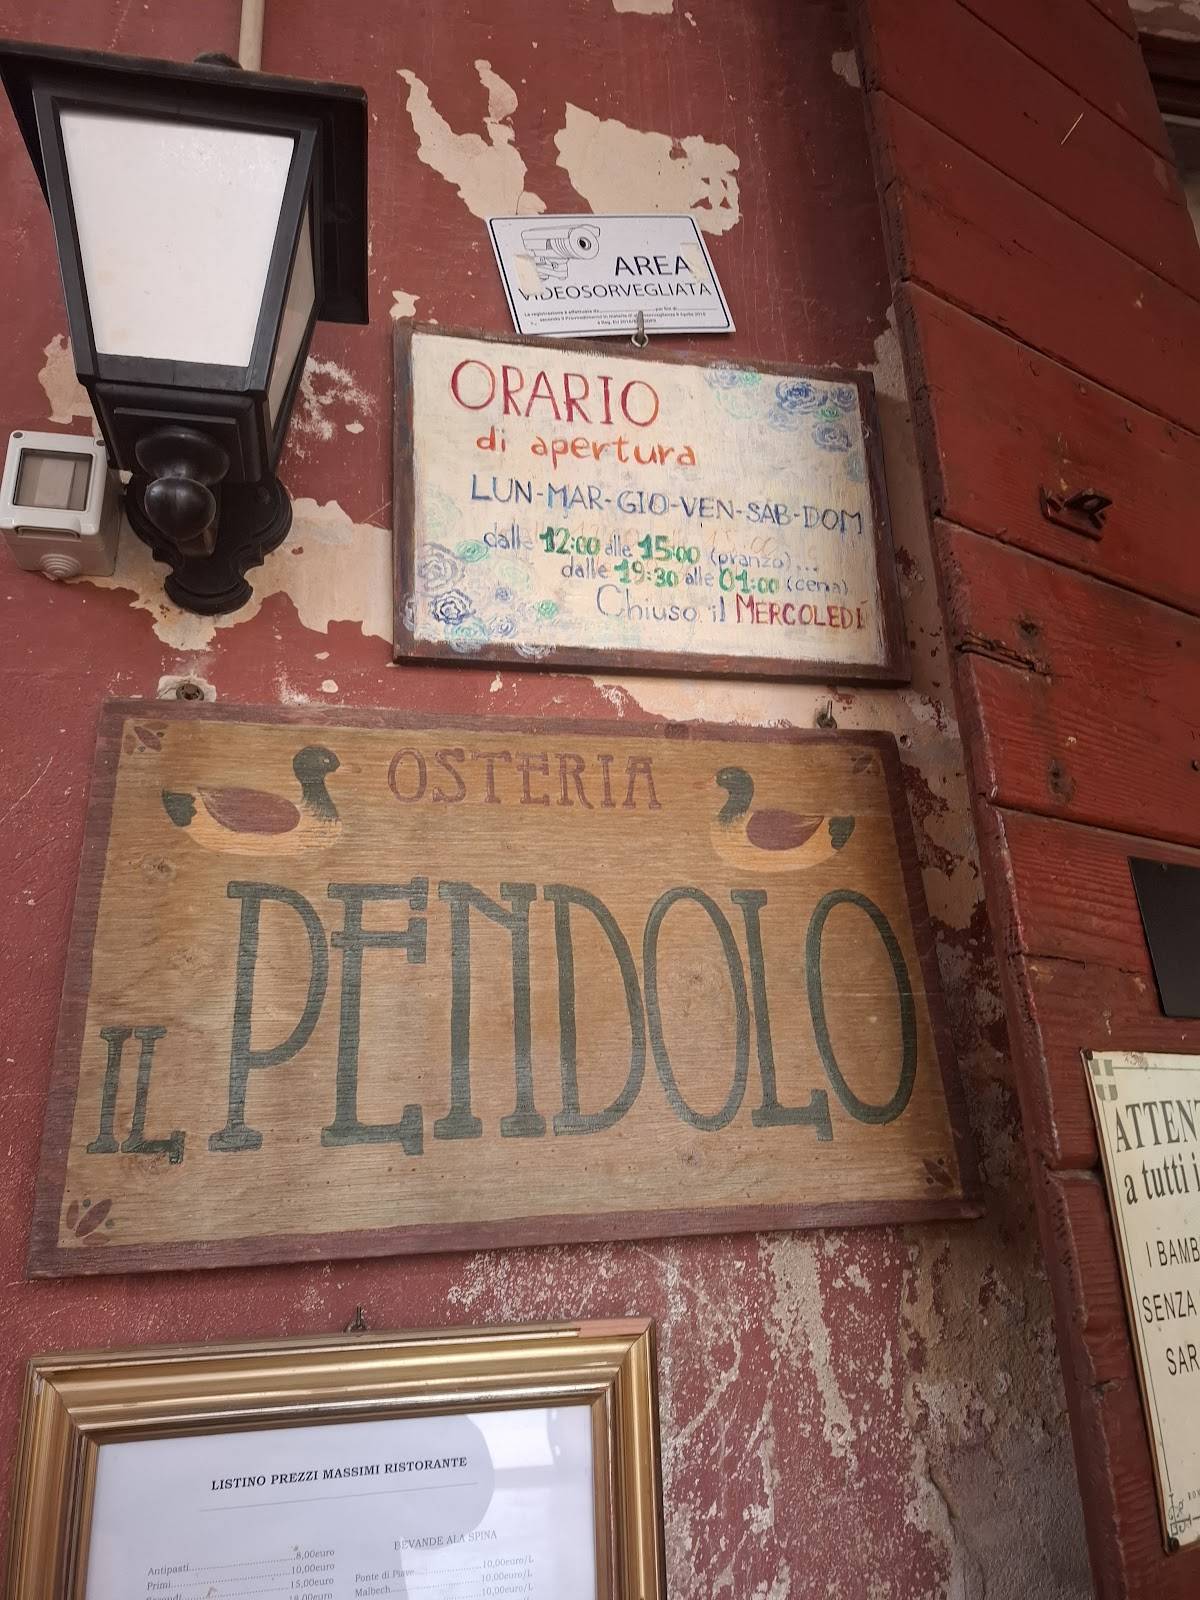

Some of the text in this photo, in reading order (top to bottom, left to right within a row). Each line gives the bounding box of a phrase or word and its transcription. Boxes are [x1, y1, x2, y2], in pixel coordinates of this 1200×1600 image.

[614, 255, 693, 277] AREA
[450, 359, 660, 427] ORARIO
[476, 426, 697, 470] di apertura
[484, 522, 533, 550] dalle
[539, 526, 600, 556] 12:00
[604, 532, 633, 558] alle
[637, 534, 700, 565] 15:00
[561, 556, 849, 595] dalle 19:30 alle 01:00 (cena)
[596, 583, 698, 622] Chiuso
[707, 596, 726, 623] il
[387, 746, 663, 811] OSTERIA
[86, 876, 918, 1166] IL PENDOLO
[1115, 1099, 1200, 1154] ATTEN
[1124, 1174, 1138, 1205] a
[1141, 1151, 1190, 1200] tutti
[1145, 1236, 1200, 1269] I BAMB
[1142, 1290, 1197, 1324] SENZA
[1166, 1343, 1200, 1376] SAR
[211, 1456, 468, 1490] LISTINO PREZZI MASSIMI RISTORANTE
[394, 1529, 497, 1550] BEVANDE ALA SPINA
[147, 1563, 190, 1577] Antipasti
[147, 1563, 335, 1591] Primi 10,00euro
[290, 1577, 334, 1590] 15,00euro
[355, 1574, 380, 1583] Ponte
[381, 1571, 390, 1580] di
[392, 1569, 415, 1579] Piave
[355, 1585, 392, 1598] Malbech
